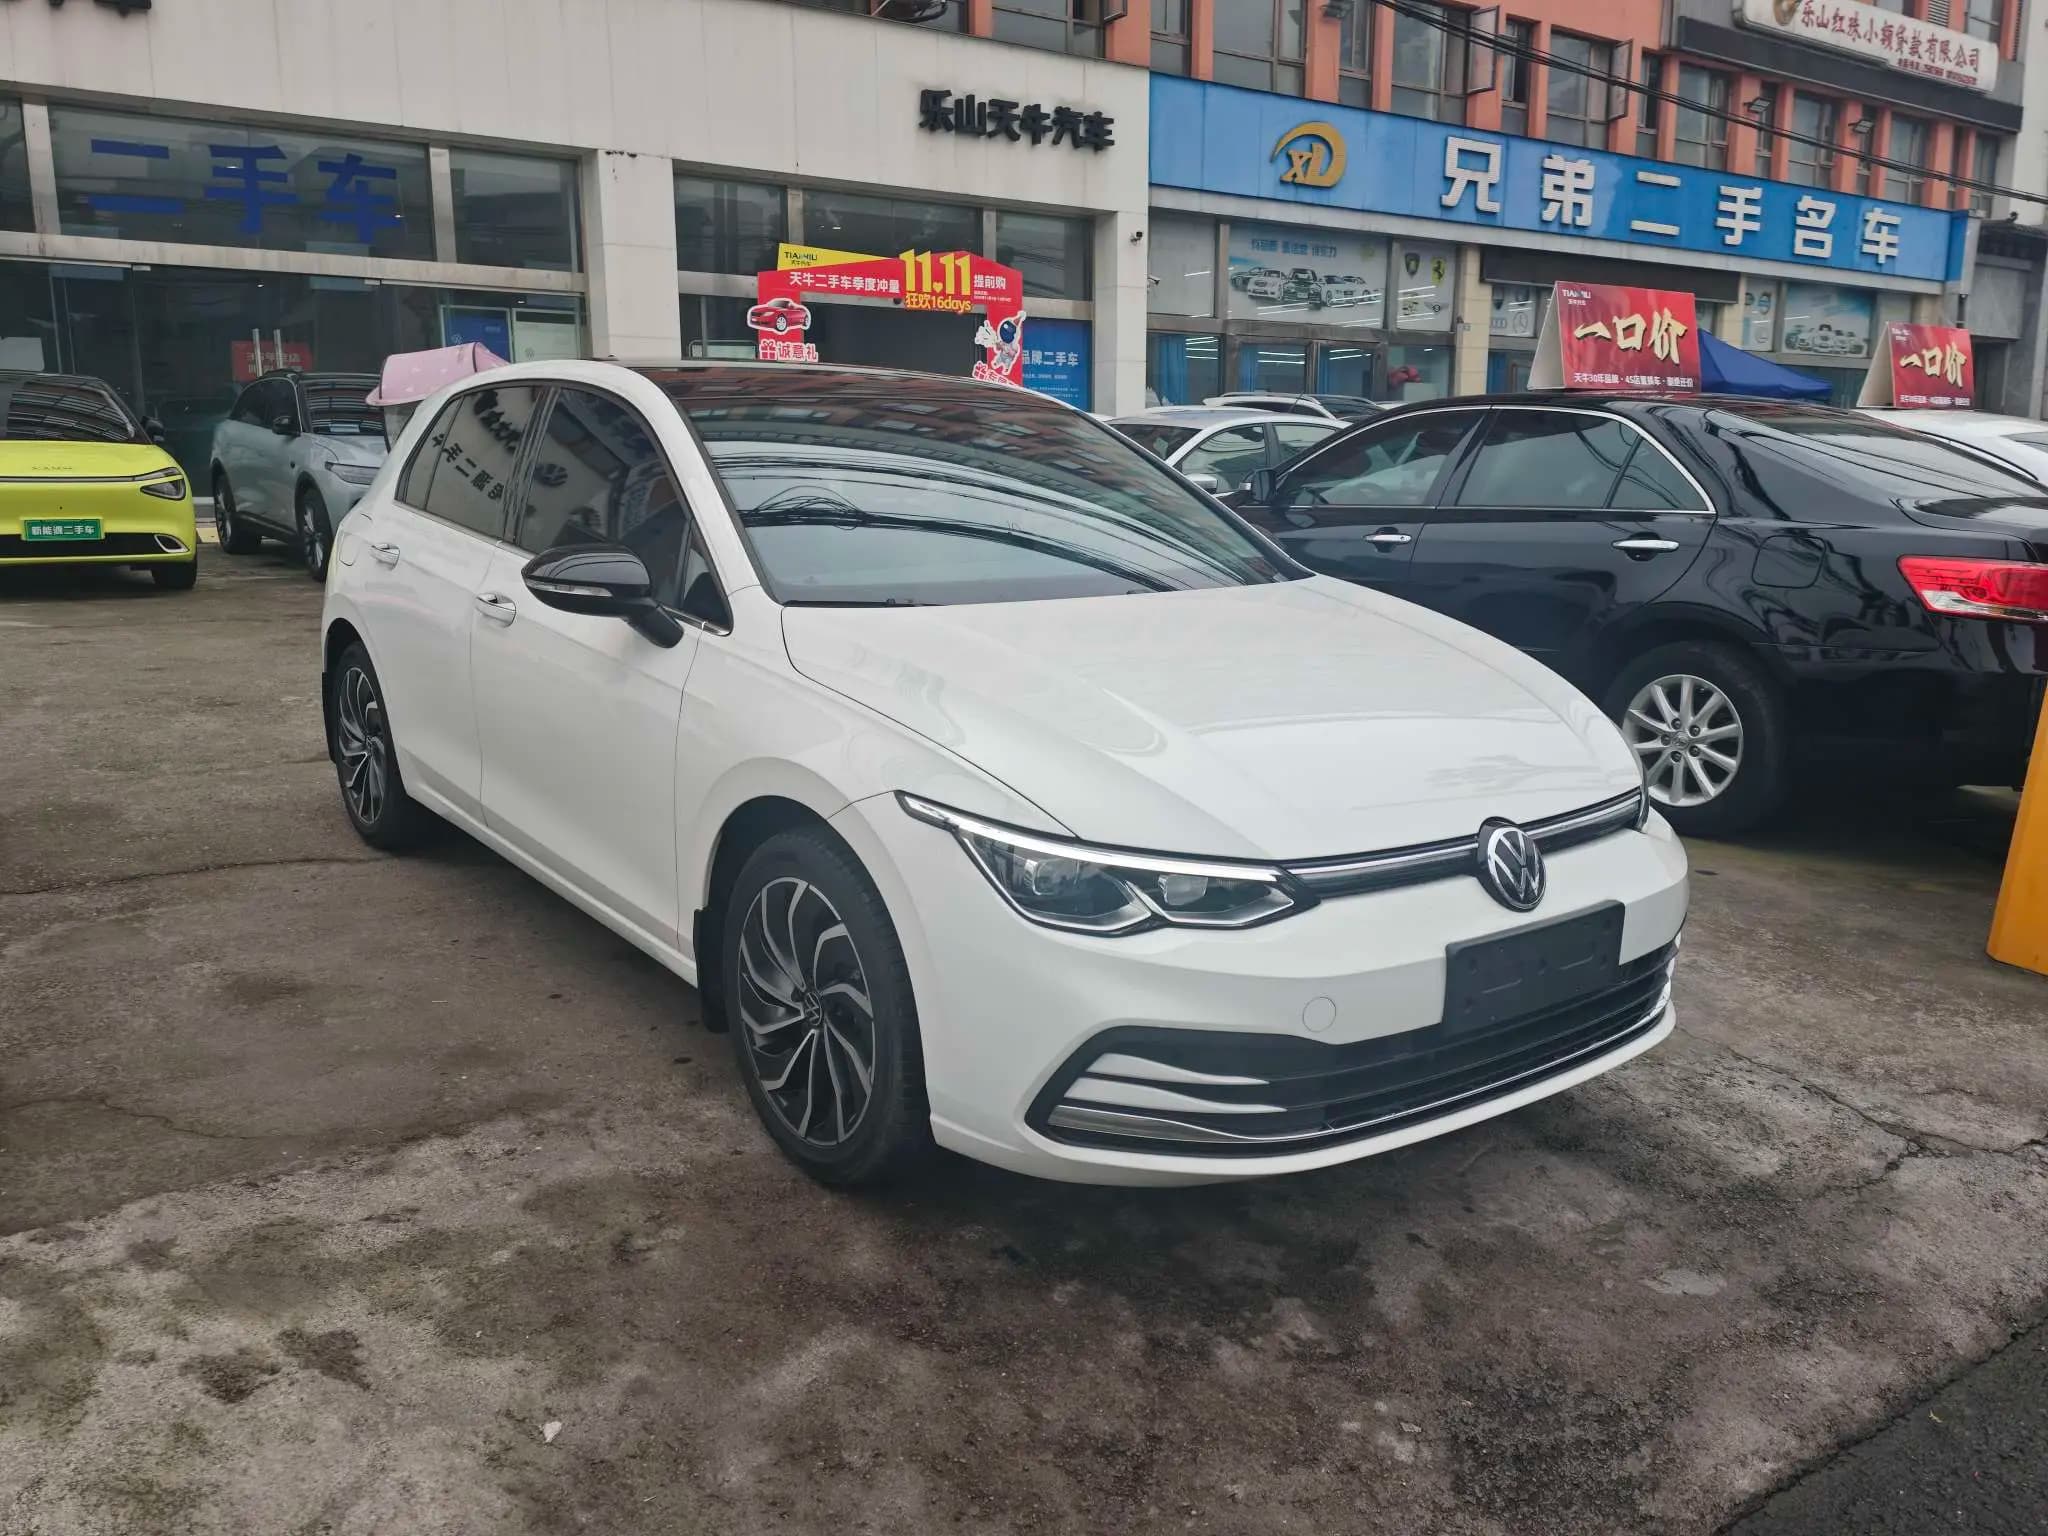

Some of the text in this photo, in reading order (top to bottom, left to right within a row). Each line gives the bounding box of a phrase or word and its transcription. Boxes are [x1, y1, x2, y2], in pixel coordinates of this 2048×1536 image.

[919, 89, 1115, 152] 乐山天牛汽车
[86, 139, 404, 244] 二手车
[1441, 136, 1902, 264] 兄弟二手名车
[789, 272, 900, 294] 天牛二手车季度冲量
[973, 275, 1006, 289] 提前购
[777, 344, 817, 361] 诚意礼
[1573, 307, 1688, 365] 一口价
[1899, 342, 1967, 389] 一口价
[31, 526, 95, 536] 新能源二手车
